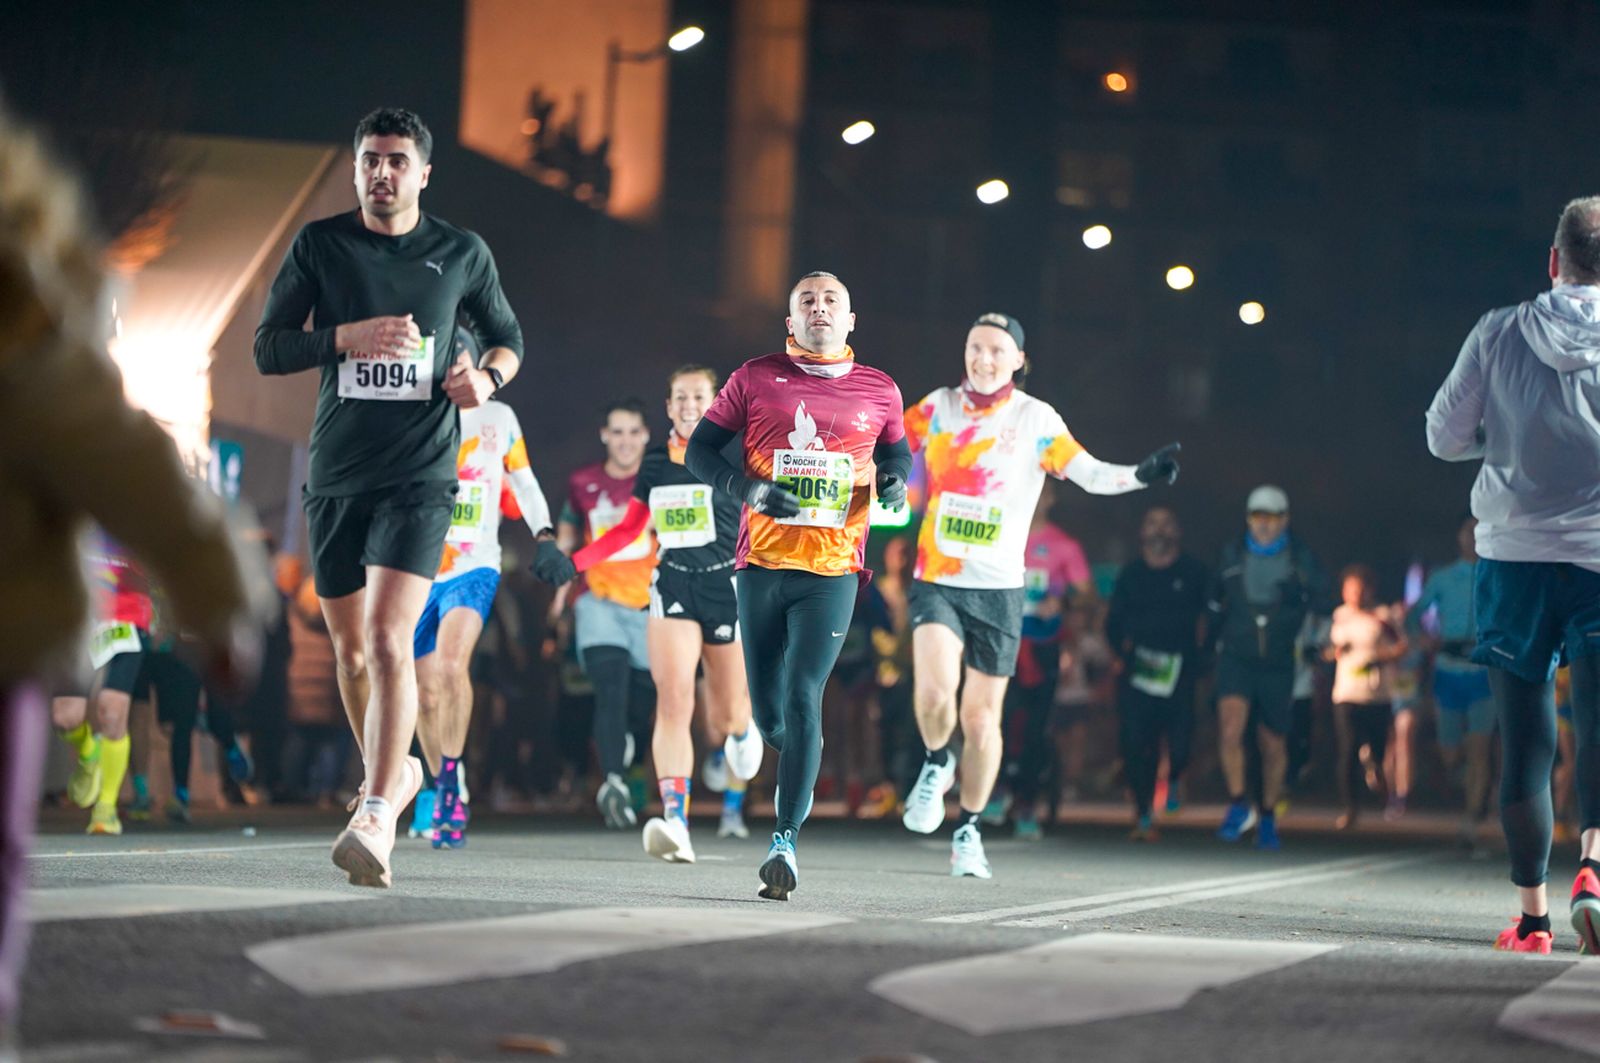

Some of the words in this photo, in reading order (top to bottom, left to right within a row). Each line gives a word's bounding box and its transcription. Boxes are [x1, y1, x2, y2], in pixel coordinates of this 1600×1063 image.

[356, 362, 417, 388] 5094
[782, 467, 799, 475] SAN
[792, 459, 816, 467] NOCHE
[790, 476, 839, 502] 7064
[666, 507, 696, 526] 656
[946, 517, 997, 541] 14002
